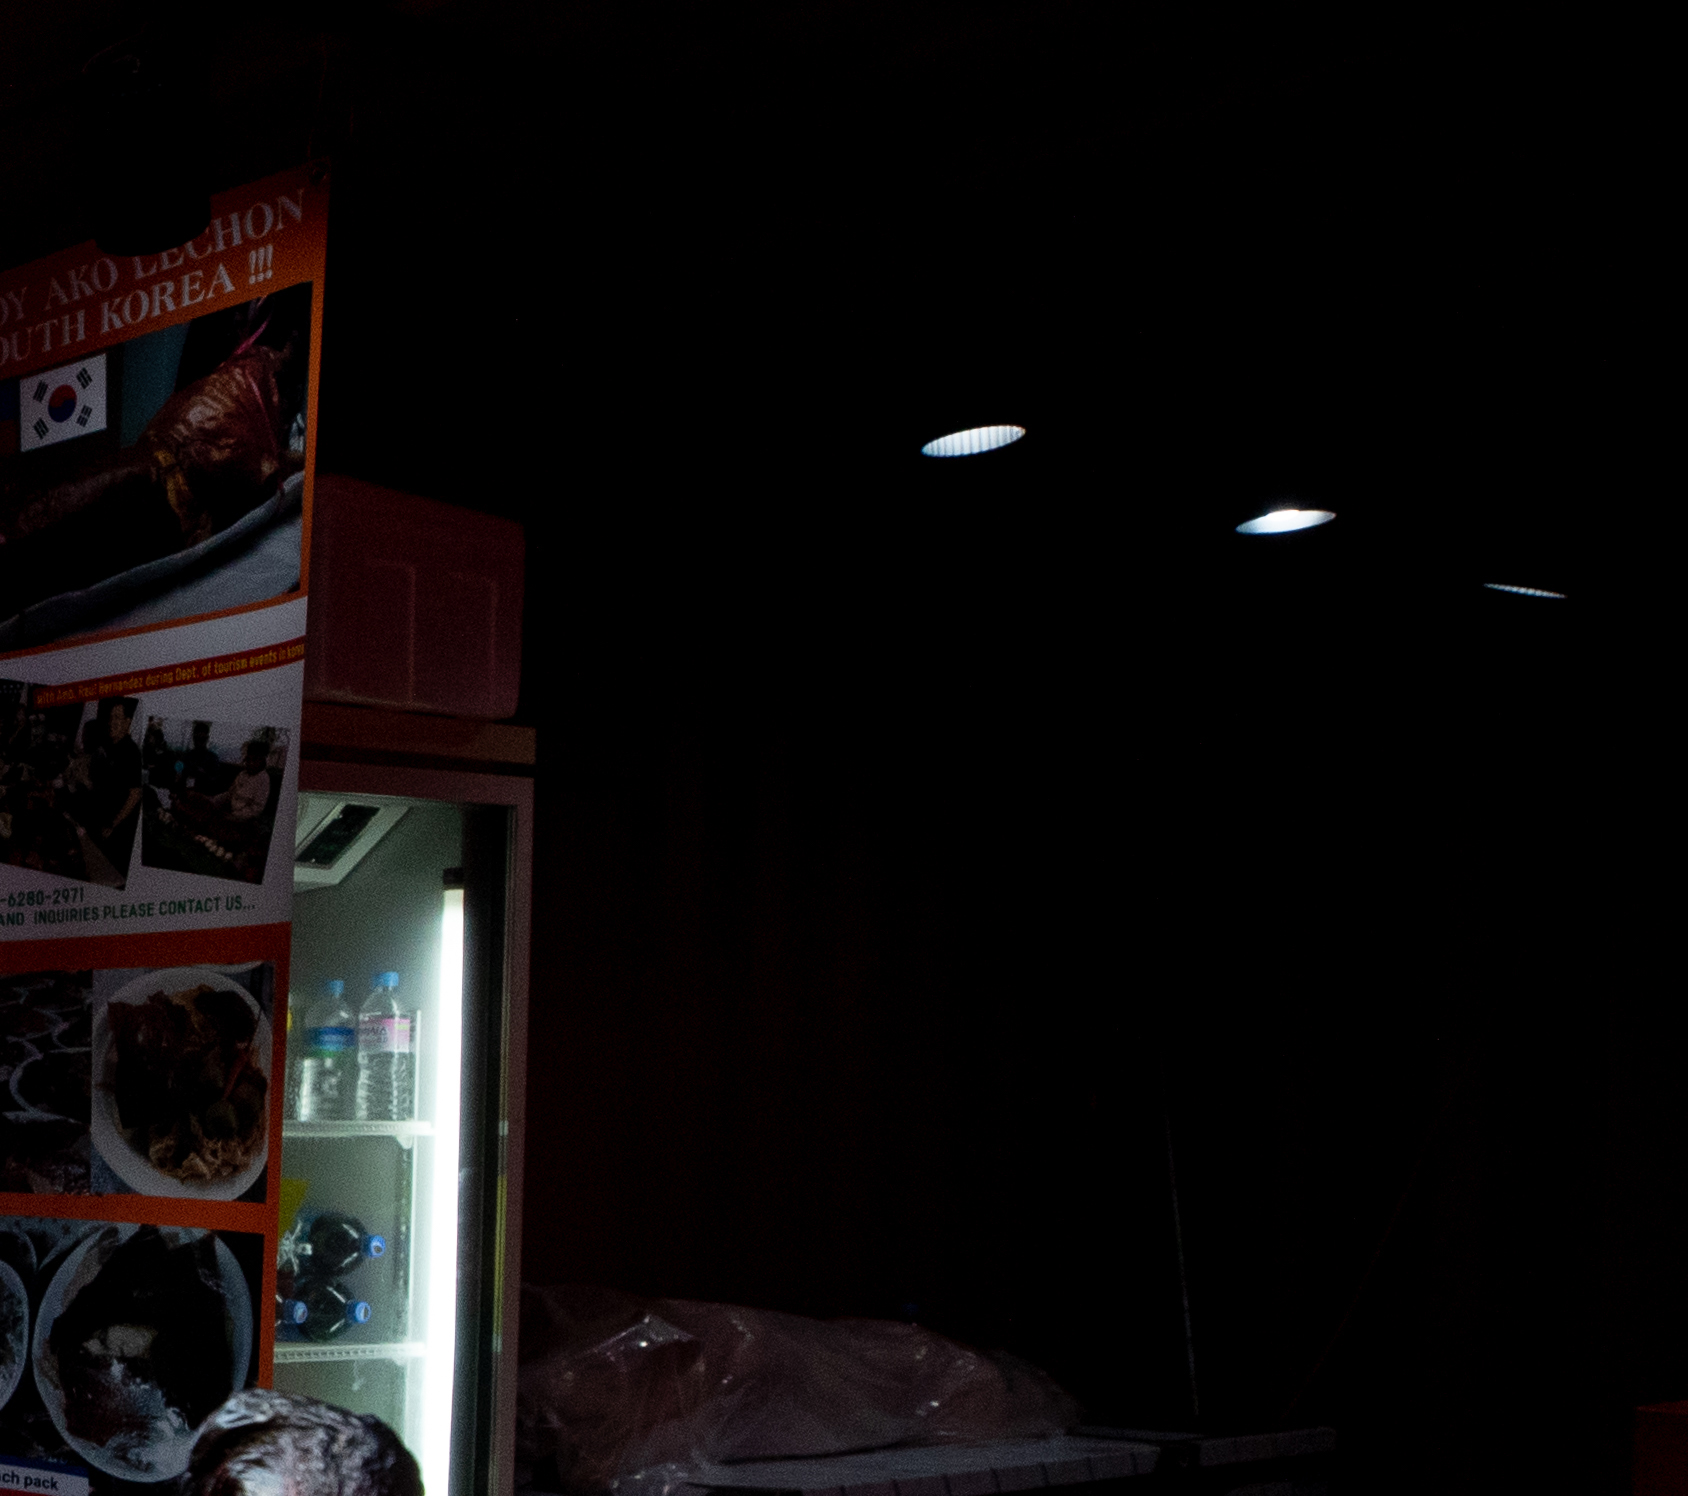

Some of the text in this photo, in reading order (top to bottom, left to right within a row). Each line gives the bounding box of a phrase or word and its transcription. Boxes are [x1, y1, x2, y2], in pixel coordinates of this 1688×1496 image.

[44, 258, 120, 311] AKO
[132, 188, 305, 281] LECHON
[98, 262, 235, 335] KOREA
[146, 671, 174, 687] during
[175, 665, 200, 681] Dept.
[201, 662, 212, 677] of
[214, 657, 248, 675] tourism
[249, 650, 278, 668] events
[34, 907, 99, 925] INQUIRIES
[103, 902, 155, 920] PLEASE
[159, 896, 221, 916] CONTACT
[23, 1475, 59, 1492] pack
